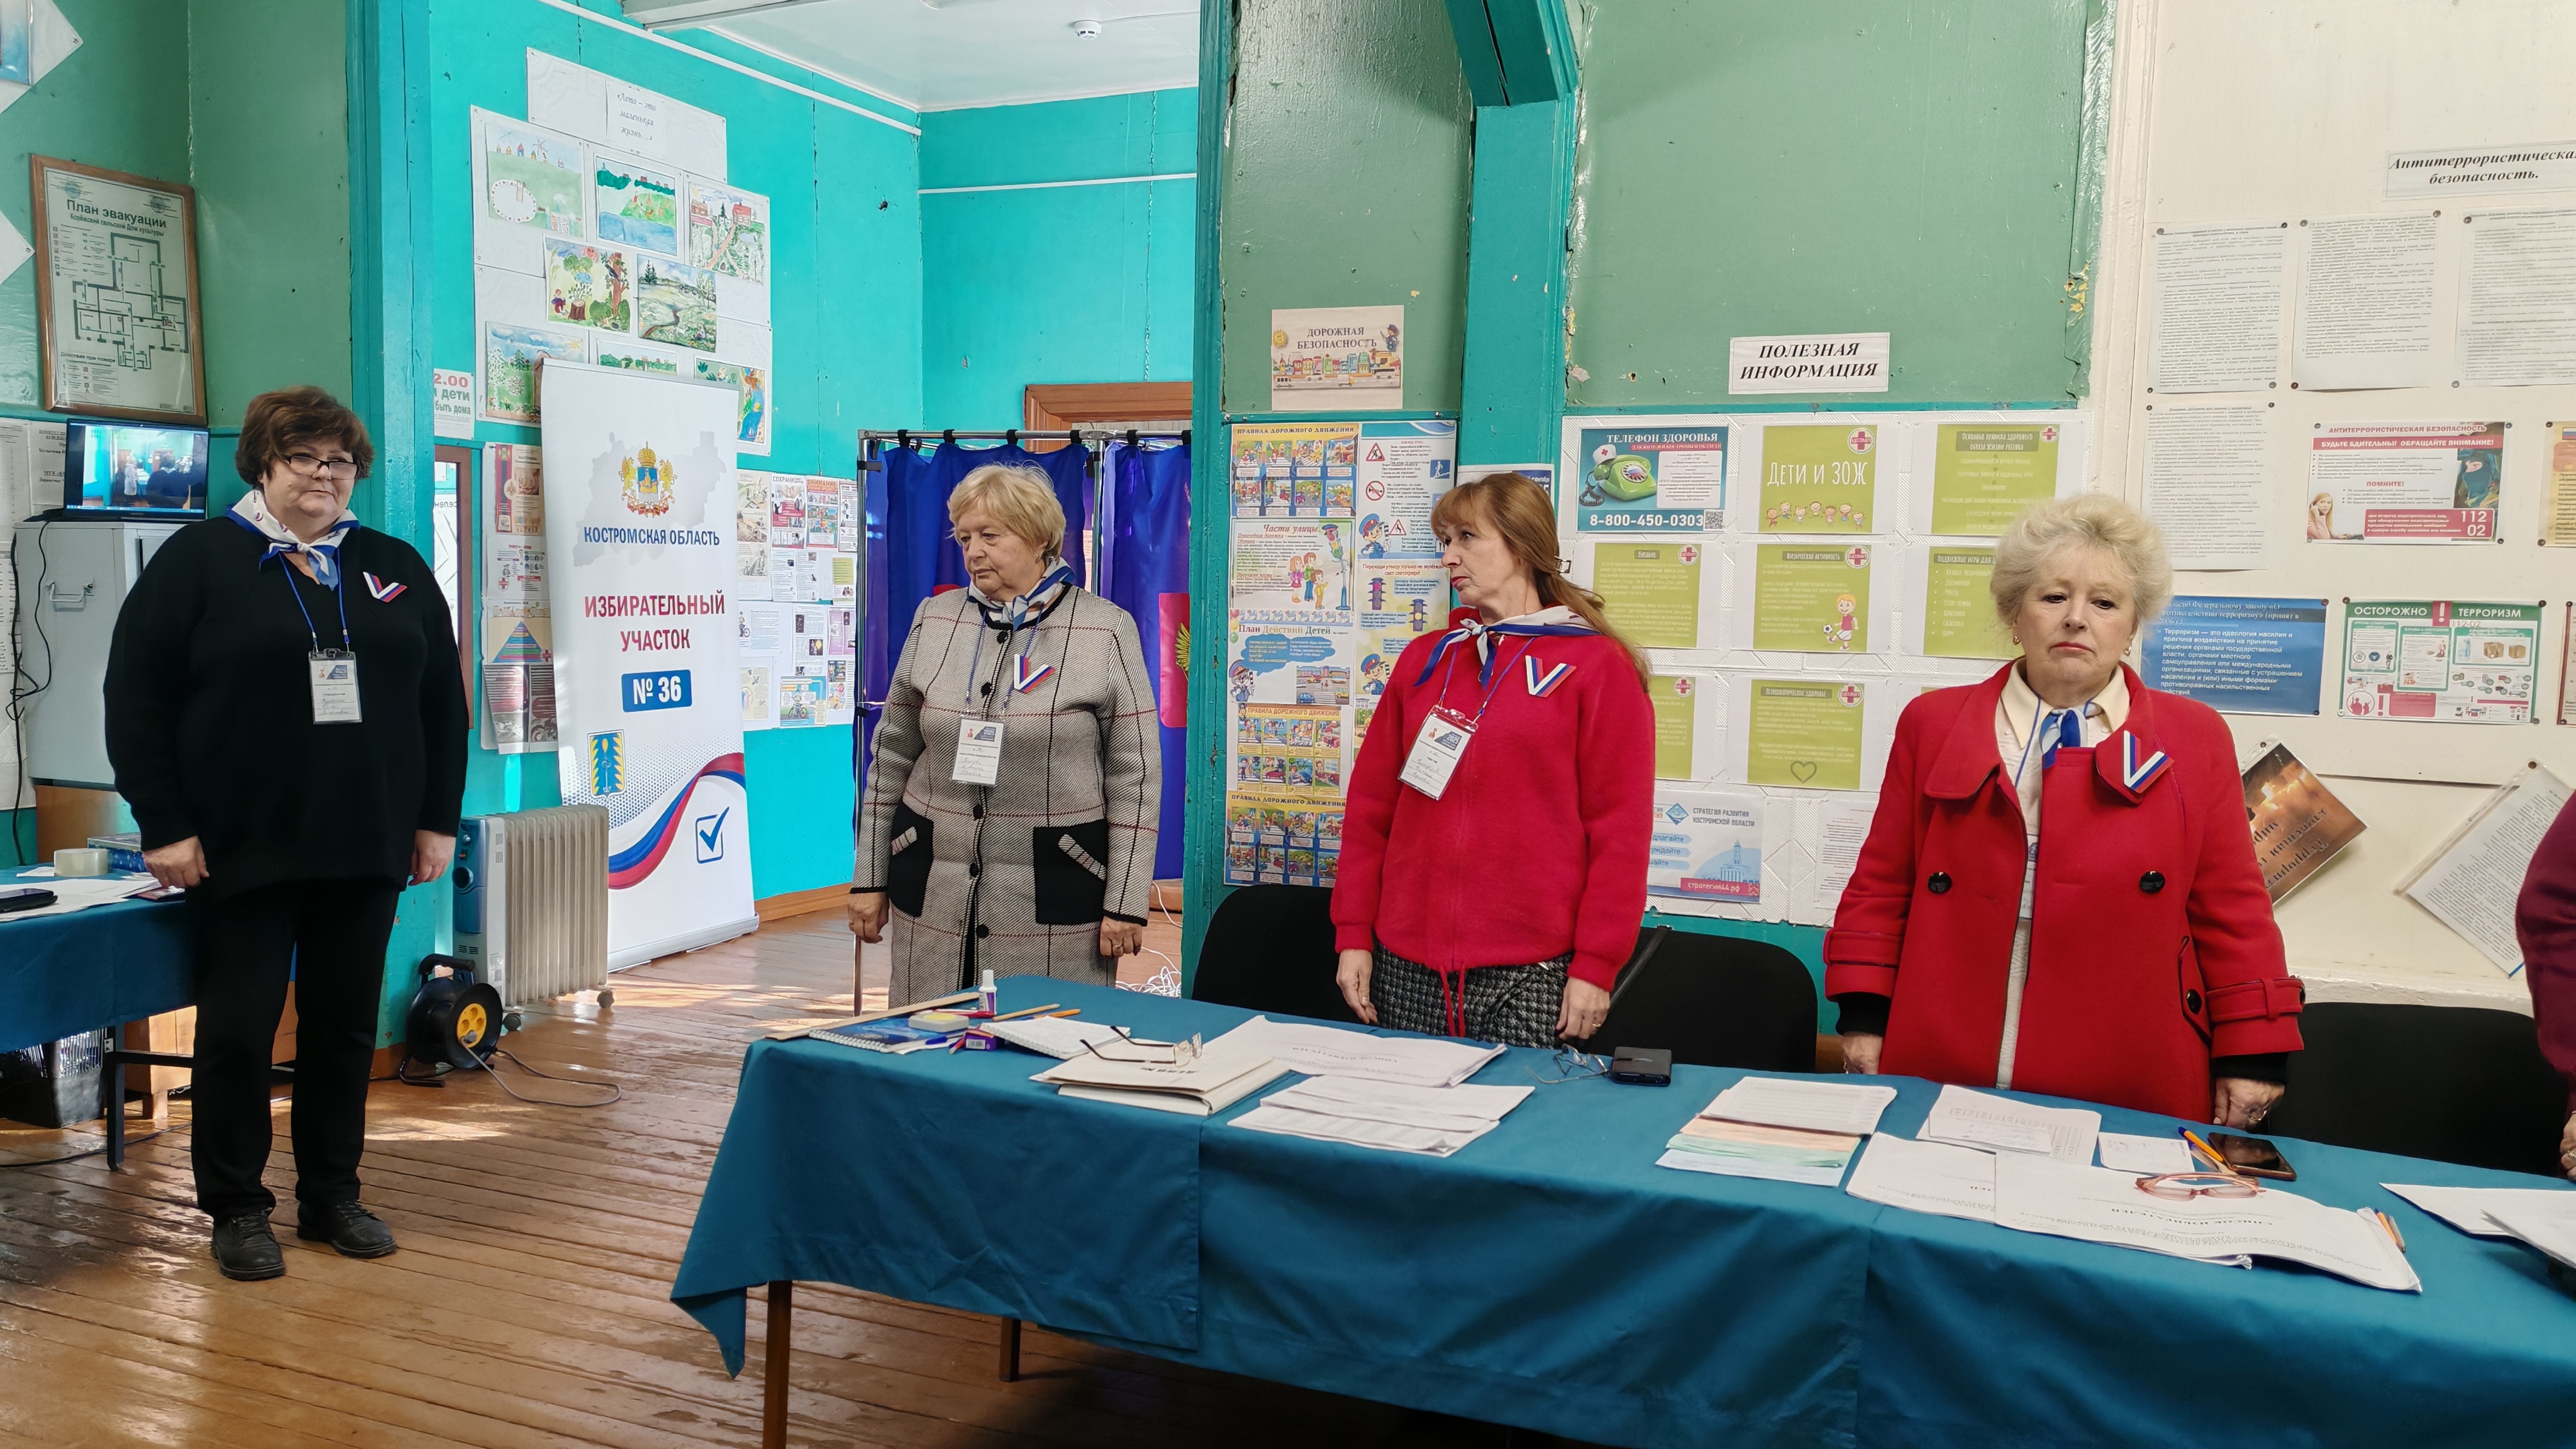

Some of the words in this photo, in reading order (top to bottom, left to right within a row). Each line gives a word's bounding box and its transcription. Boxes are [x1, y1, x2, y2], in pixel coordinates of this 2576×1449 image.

[619, 111, 654, 126] маленькая
[2429, 170, 2538, 184] безопасность.
[67, 199, 98, 215] План
[103, 209, 166, 228] эвакуации
[1307, 327, 1364, 338] ДОРОЖНАЯ
[1297, 339, 1377, 349] БЕЗОПАСНОСТЬ
[1758, 343, 1860, 358] ПОЛЕЗНАЯ
[1739, 363, 1879, 379] ИНФОРМАЦИЯ
[434, 373, 468, 387] 2.00
[441, 388, 470, 401] дети
[436, 401, 452, 413] быть
[453, 406, 470, 415] дома
[1607, 434, 1658, 443] ТЕЛЕФОН
[1662, 433, 1718, 443] ЗДОРОВЬЯ
[1832, 462, 1868, 485] ЗОЖ
[1590, 514, 1703, 526] 8-800-450-0303
[2462, 511, 2487, 523] 112
[1263, 525, 1290, 533] Части
[2467, 525, 2485, 536] 02
[584, 527, 667, 545] КОСТРОМСКАЯ
[670, 530, 719, 546] ОБЛАСТЬ
[584, 590, 724, 618] ИЗБИРАТЕЛЬНЫЙ
[2354, 607, 2427, 616] ОСТОРОЖНО
[2458, 609, 2521, 618] ТЕРРОРИЗМ
[1262, 625, 1302, 635] Действий
[1306, 626, 1330, 635] Детей
[620, 629, 691, 652] УЧАСТОК
[633, 678, 653, 704] №
[658, 676, 681, 703] 36
[1693, 817, 1729, 825] КОСТРОМСКОЙ
[1688, 882, 1740, 893] стратегия44.рф
